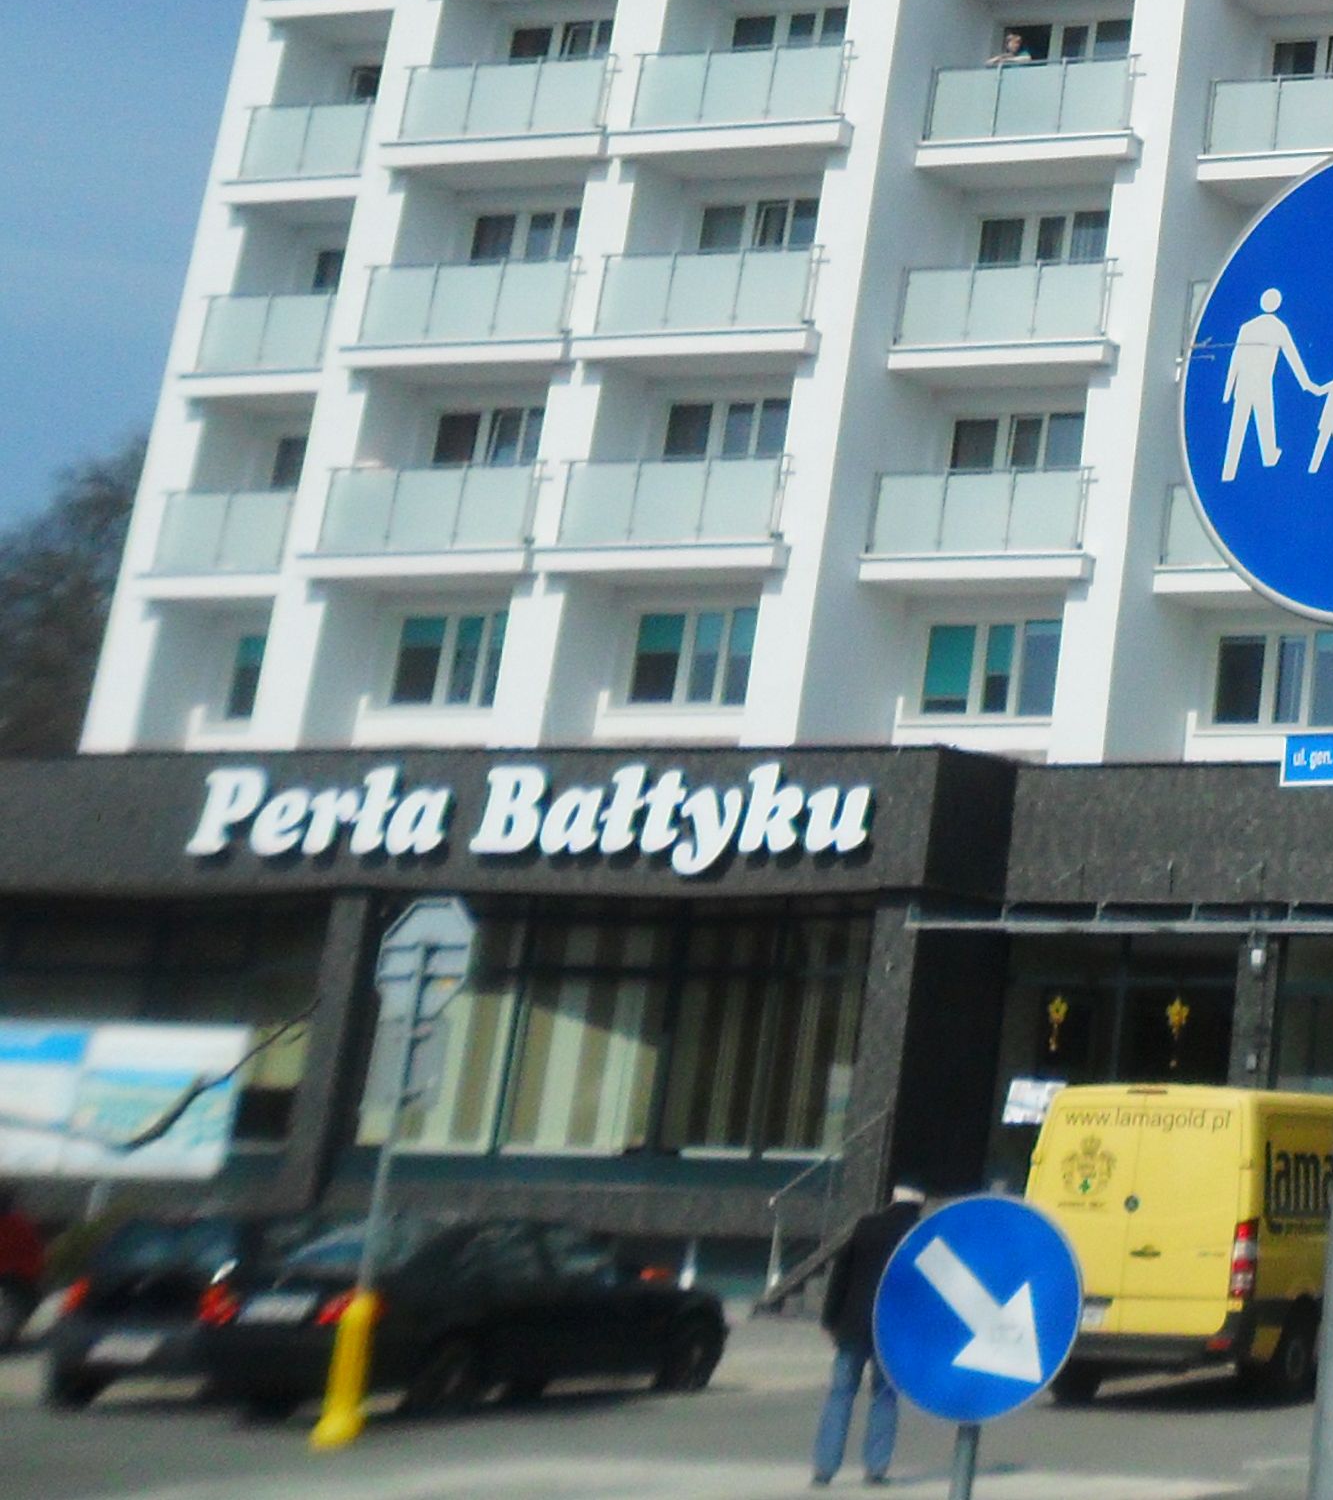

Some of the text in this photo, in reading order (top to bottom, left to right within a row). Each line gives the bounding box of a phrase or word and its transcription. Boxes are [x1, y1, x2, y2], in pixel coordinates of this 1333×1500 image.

[1293, 747, 1306, 767] ul.
[1310, 750, 1333, 770] gen.
[184, 762, 873, 876] Perła Bałtyku
[1065, 1108, 1231, 1132] www.lamagold.pl
